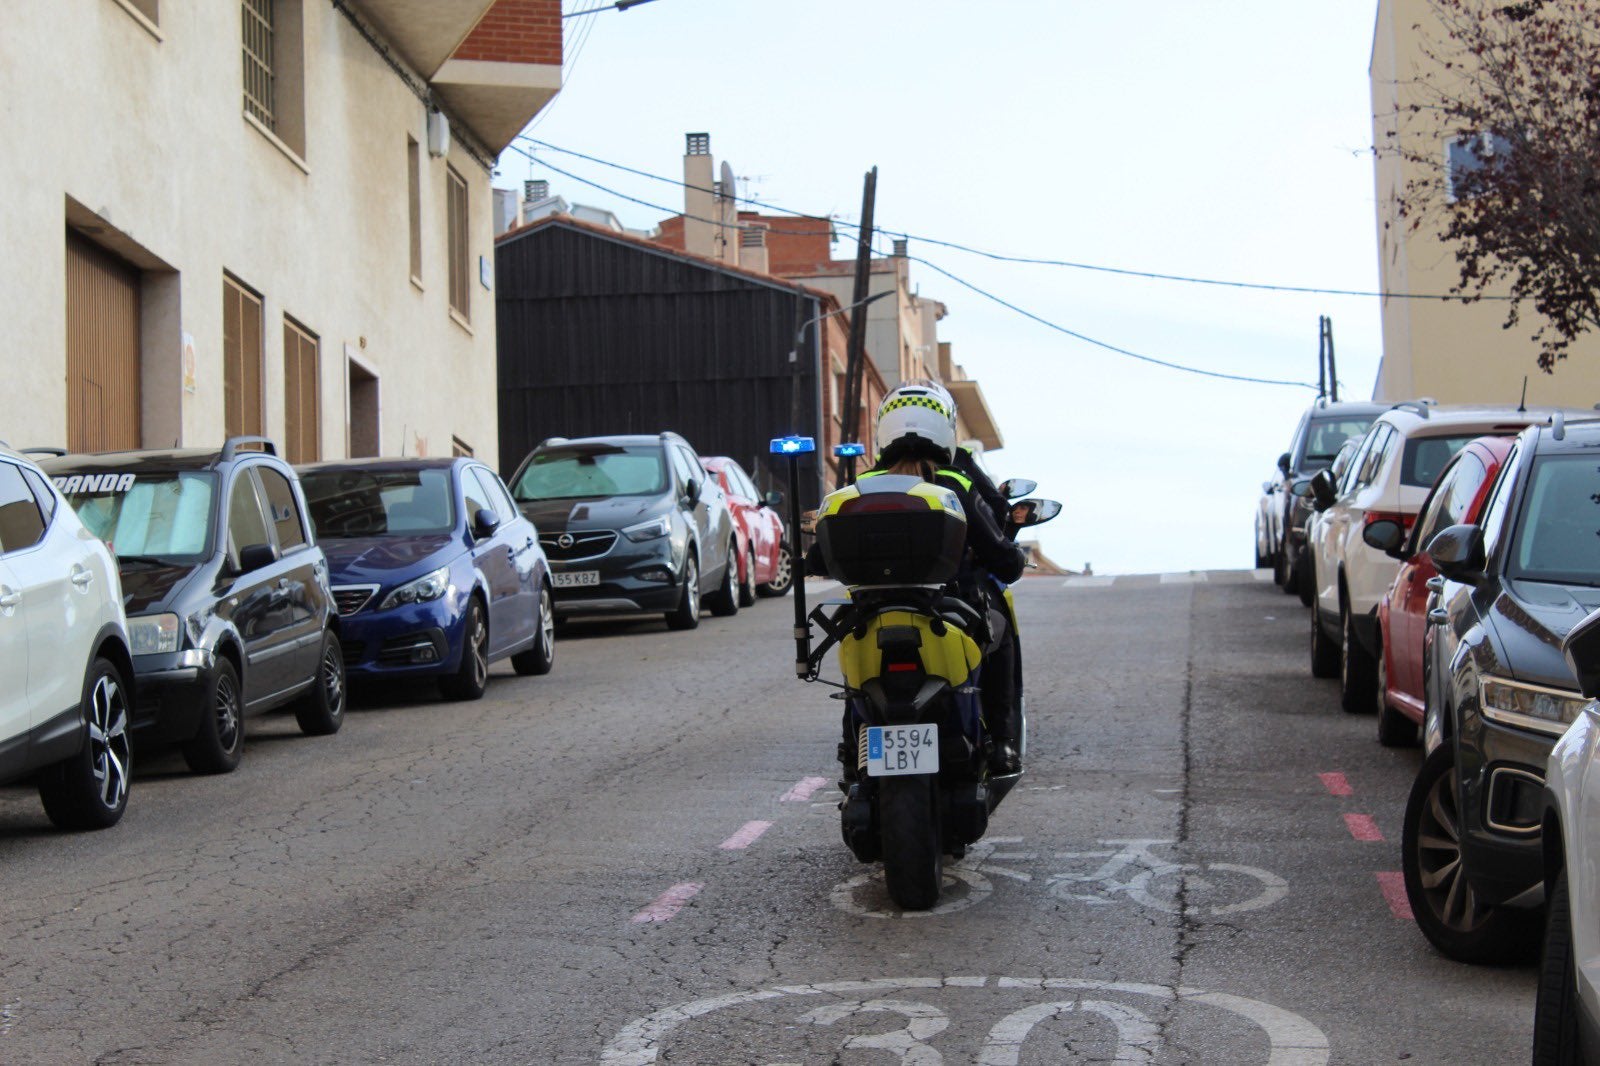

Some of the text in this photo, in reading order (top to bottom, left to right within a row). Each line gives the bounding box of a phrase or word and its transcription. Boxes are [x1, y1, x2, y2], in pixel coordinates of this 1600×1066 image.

[52, 473, 136, 493] PANDA
[884, 728, 933, 749] 5594
[884, 750, 920, 770] LBY
